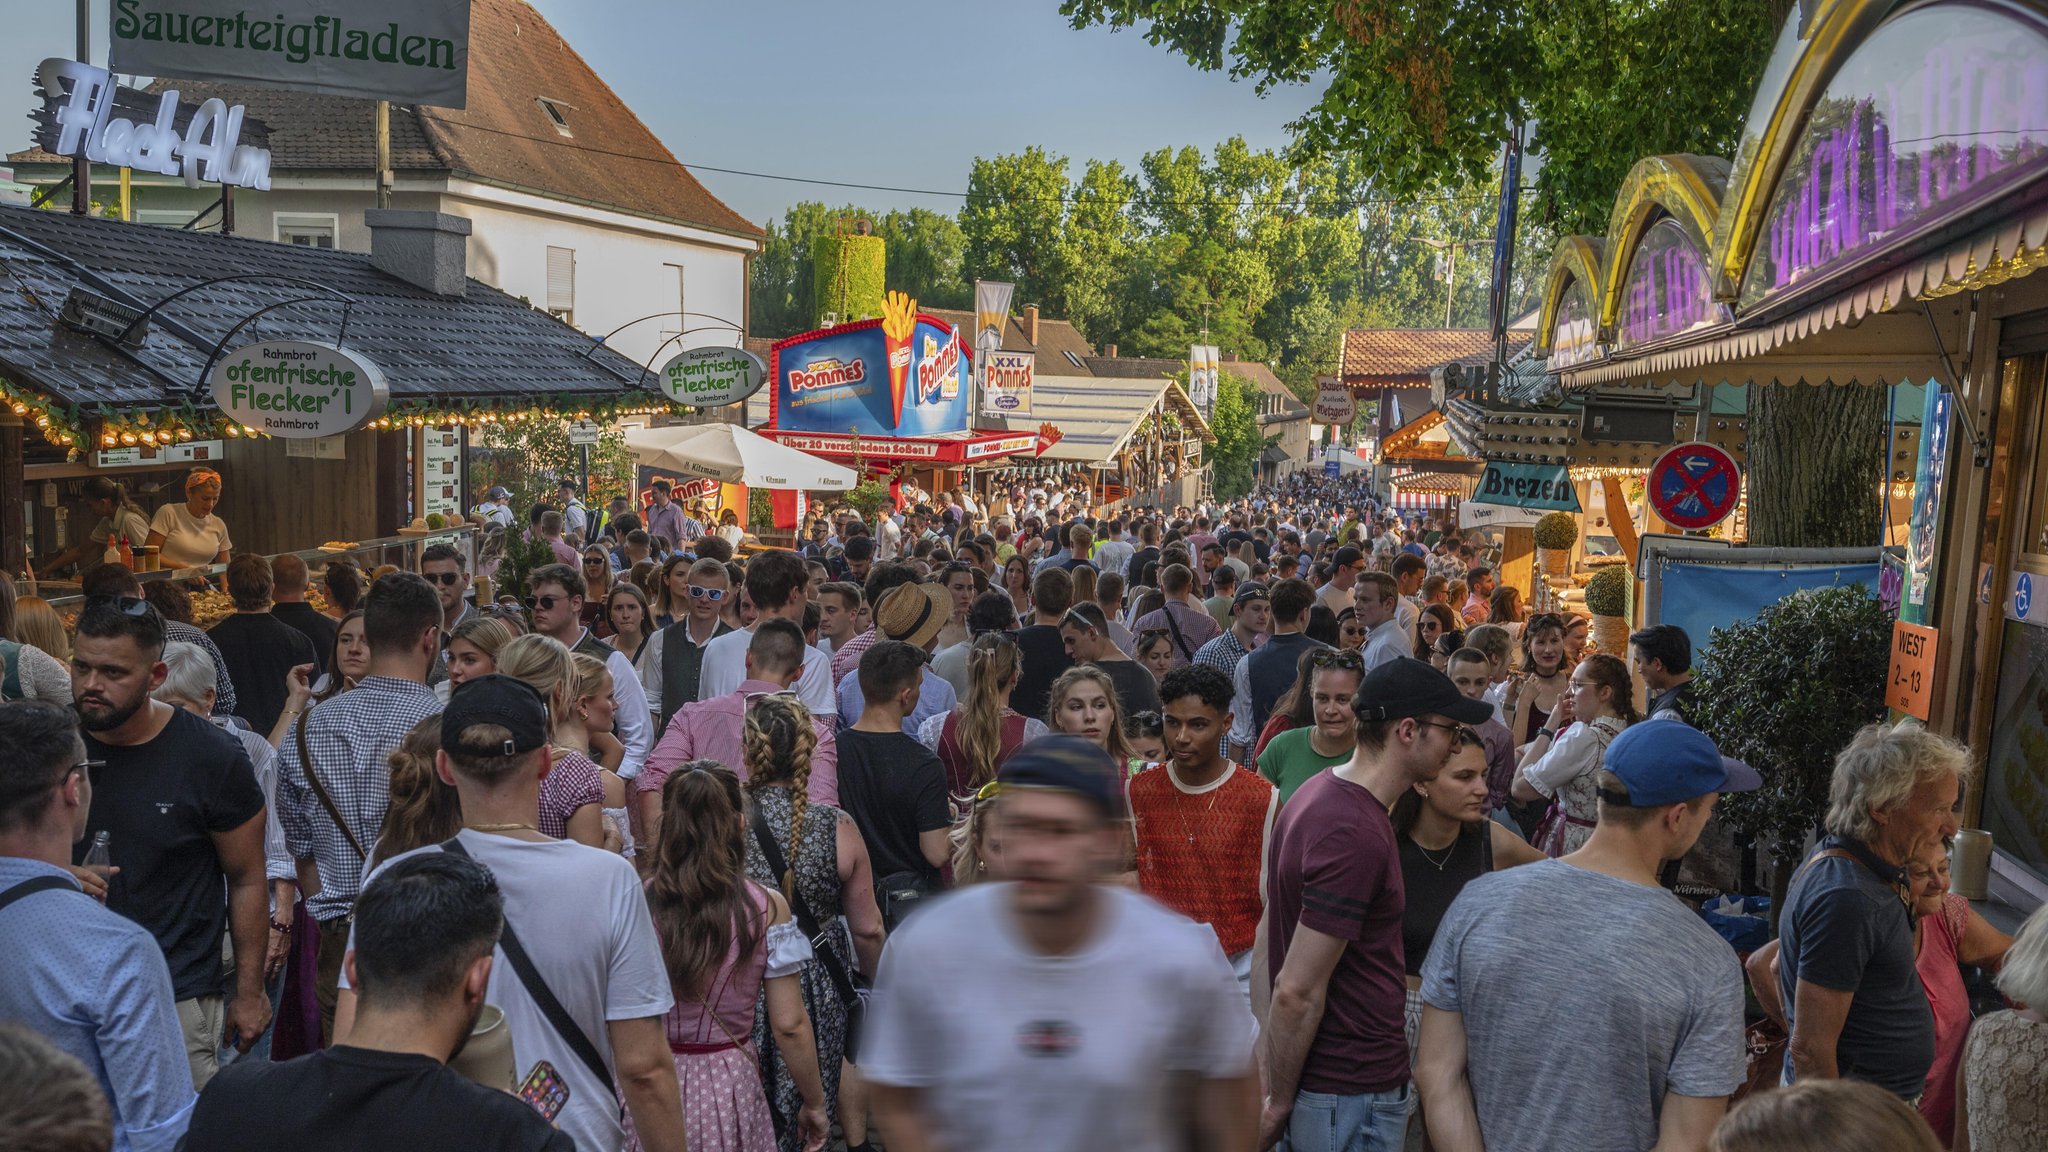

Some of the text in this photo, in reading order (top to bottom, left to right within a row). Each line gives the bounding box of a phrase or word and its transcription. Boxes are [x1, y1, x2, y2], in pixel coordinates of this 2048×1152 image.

[114, 0, 457, 71] Sauerteigfladen
[263, 348, 318, 361] Rahmbrot
[689, 351, 724, 360] Rahmbrot
[668, 356, 750, 378] ofenfrische
[995, 357, 1024, 368] XXL
[227, 359, 356, 387] ofenfrische
[695, 394, 729, 403] Rahmbrot
[265, 418, 320, 430] Rahmbrot
[783, 436, 807, 448] Über
[809, 439, 822, 449] 20
[893, 444, 925, 455] Soßen
[691, 462, 720, 476] Kitzmann
[766, 476, 787, 484] Kitzmann
[823, 476, 843, 486] Kitzmann
[1484, 467, 1570, 502] Brezen
[1899, 630, 1926, 658] WEST
[1894, 664, 1901, 686] 2
[1910, 670, 1921, 694] 13
[1673, 884, 1720, 897] Nürnberg
